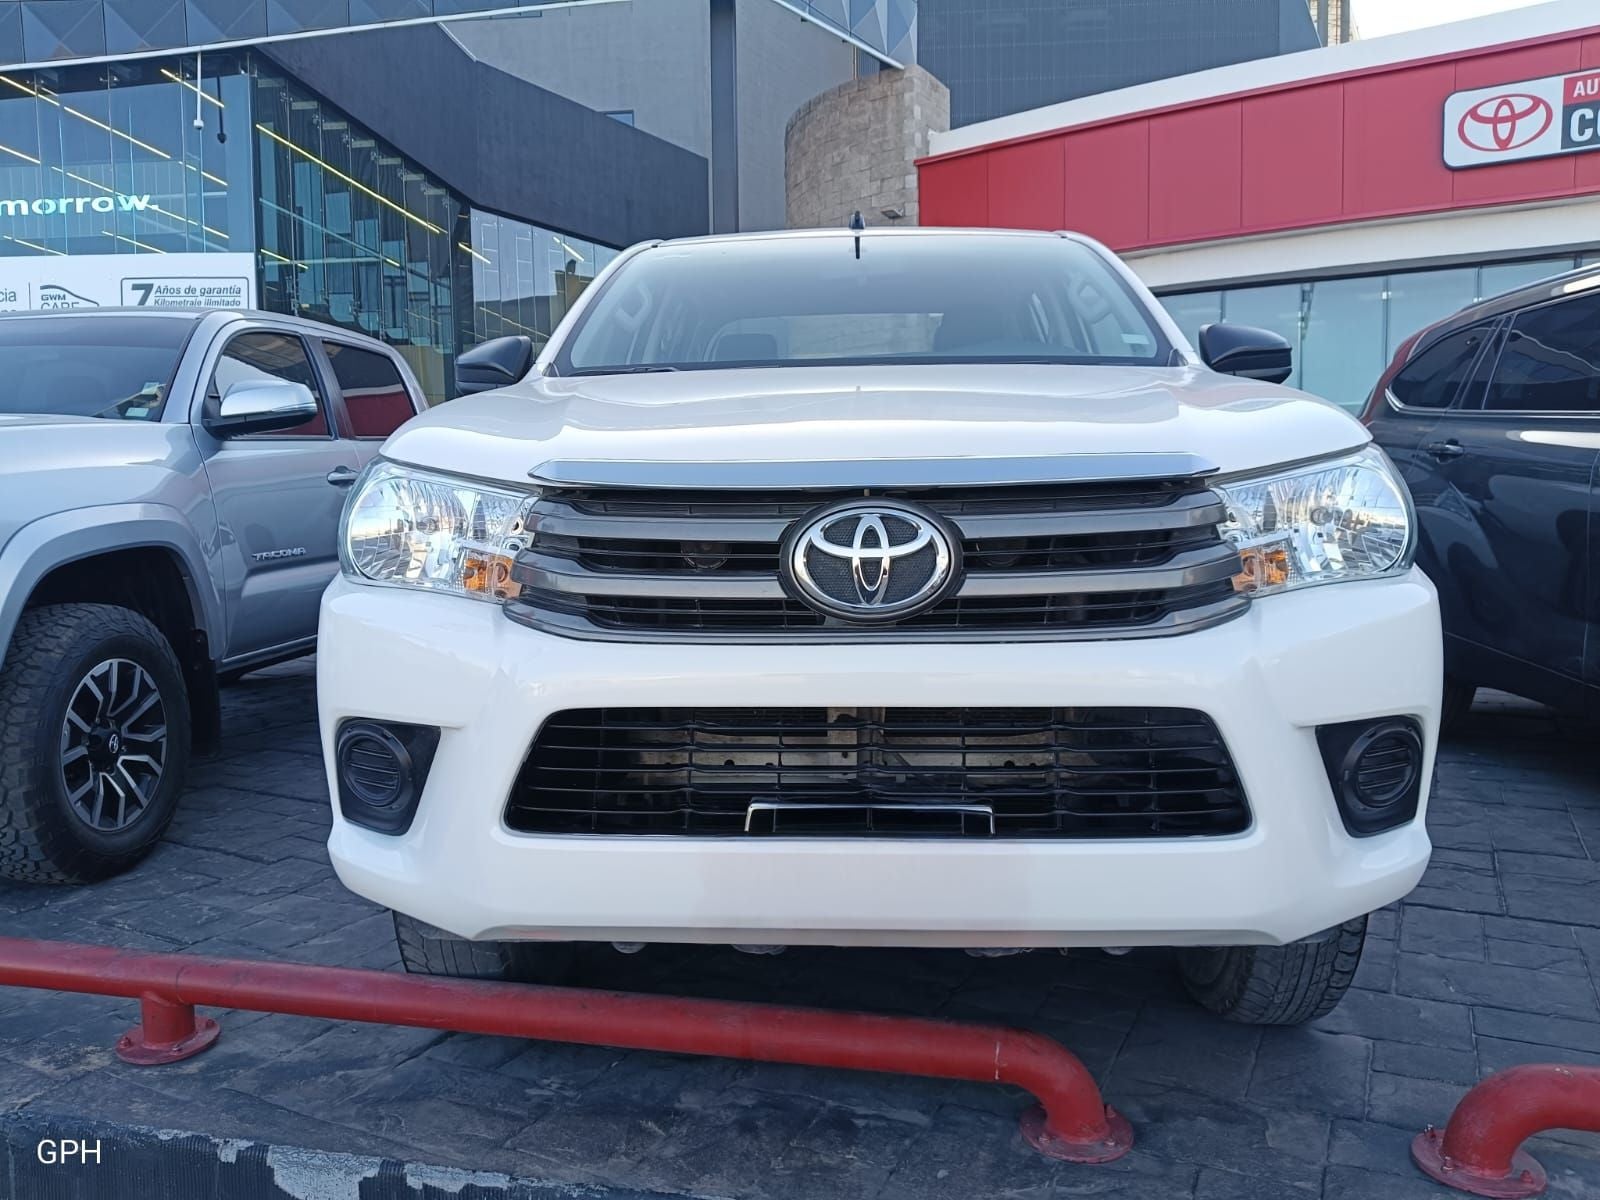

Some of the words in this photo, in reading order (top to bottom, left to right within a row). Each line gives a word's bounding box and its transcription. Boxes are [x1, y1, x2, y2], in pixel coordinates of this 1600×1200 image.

[1570, 107, 1600, 142] C
[41, 294, 66, 302] GWM
[131, 283, 154, 306] 7
[154, 285, 181, 295] Años
[184, 285, 197, 295] de
[199, 285, 241, 297] garantía
[251, 547, 307, 561] TACOMA
